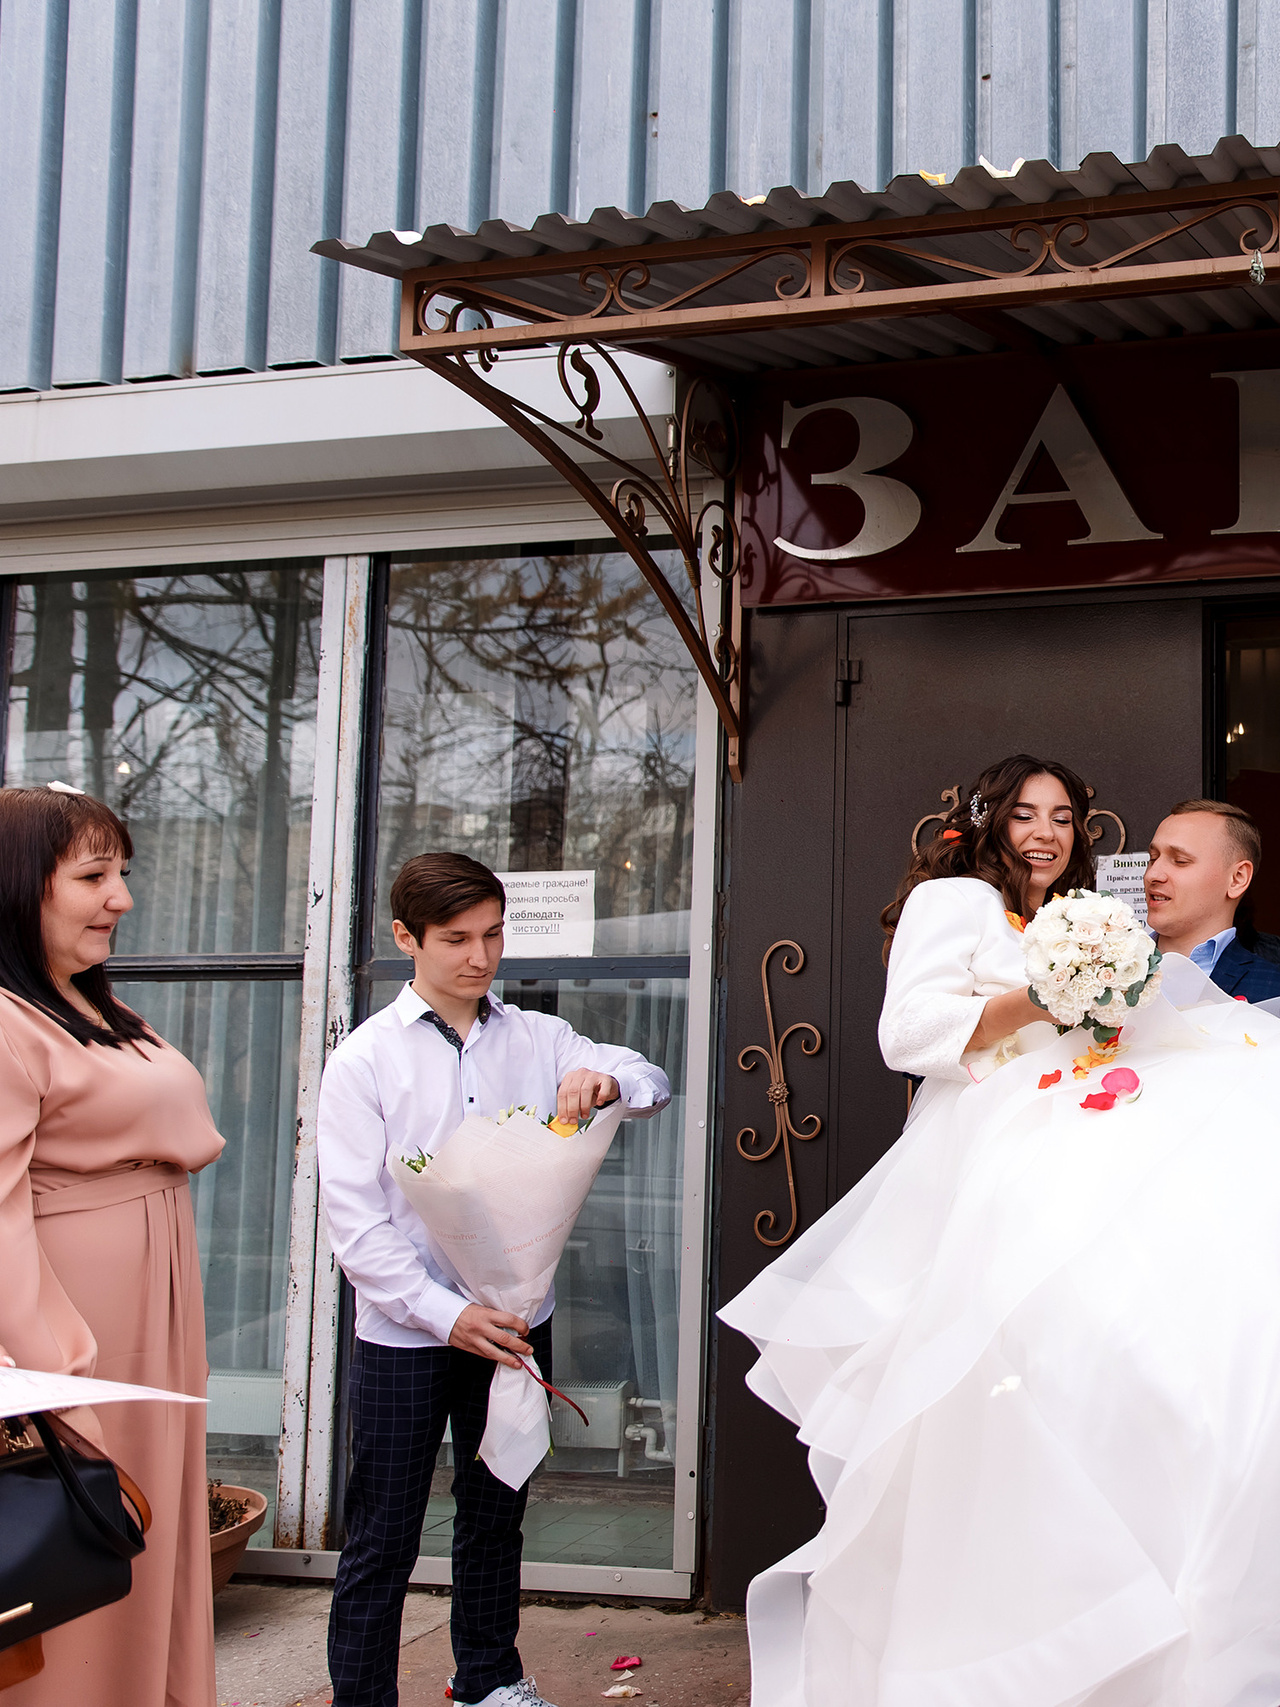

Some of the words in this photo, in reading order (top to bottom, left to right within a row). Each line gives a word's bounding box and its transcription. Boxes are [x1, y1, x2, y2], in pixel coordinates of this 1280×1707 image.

[503, 881, 540, 889] жаемые
[543, 878, 589, 889] граждане!
[506, 896, 539, 905] ромная
[542, 893, 580, 905] просьба
[509, 910, 564, 920] соблюдать
[512, 924, 560, 933] чистоту!!!
[503, 1240, 534, 1255] Original
